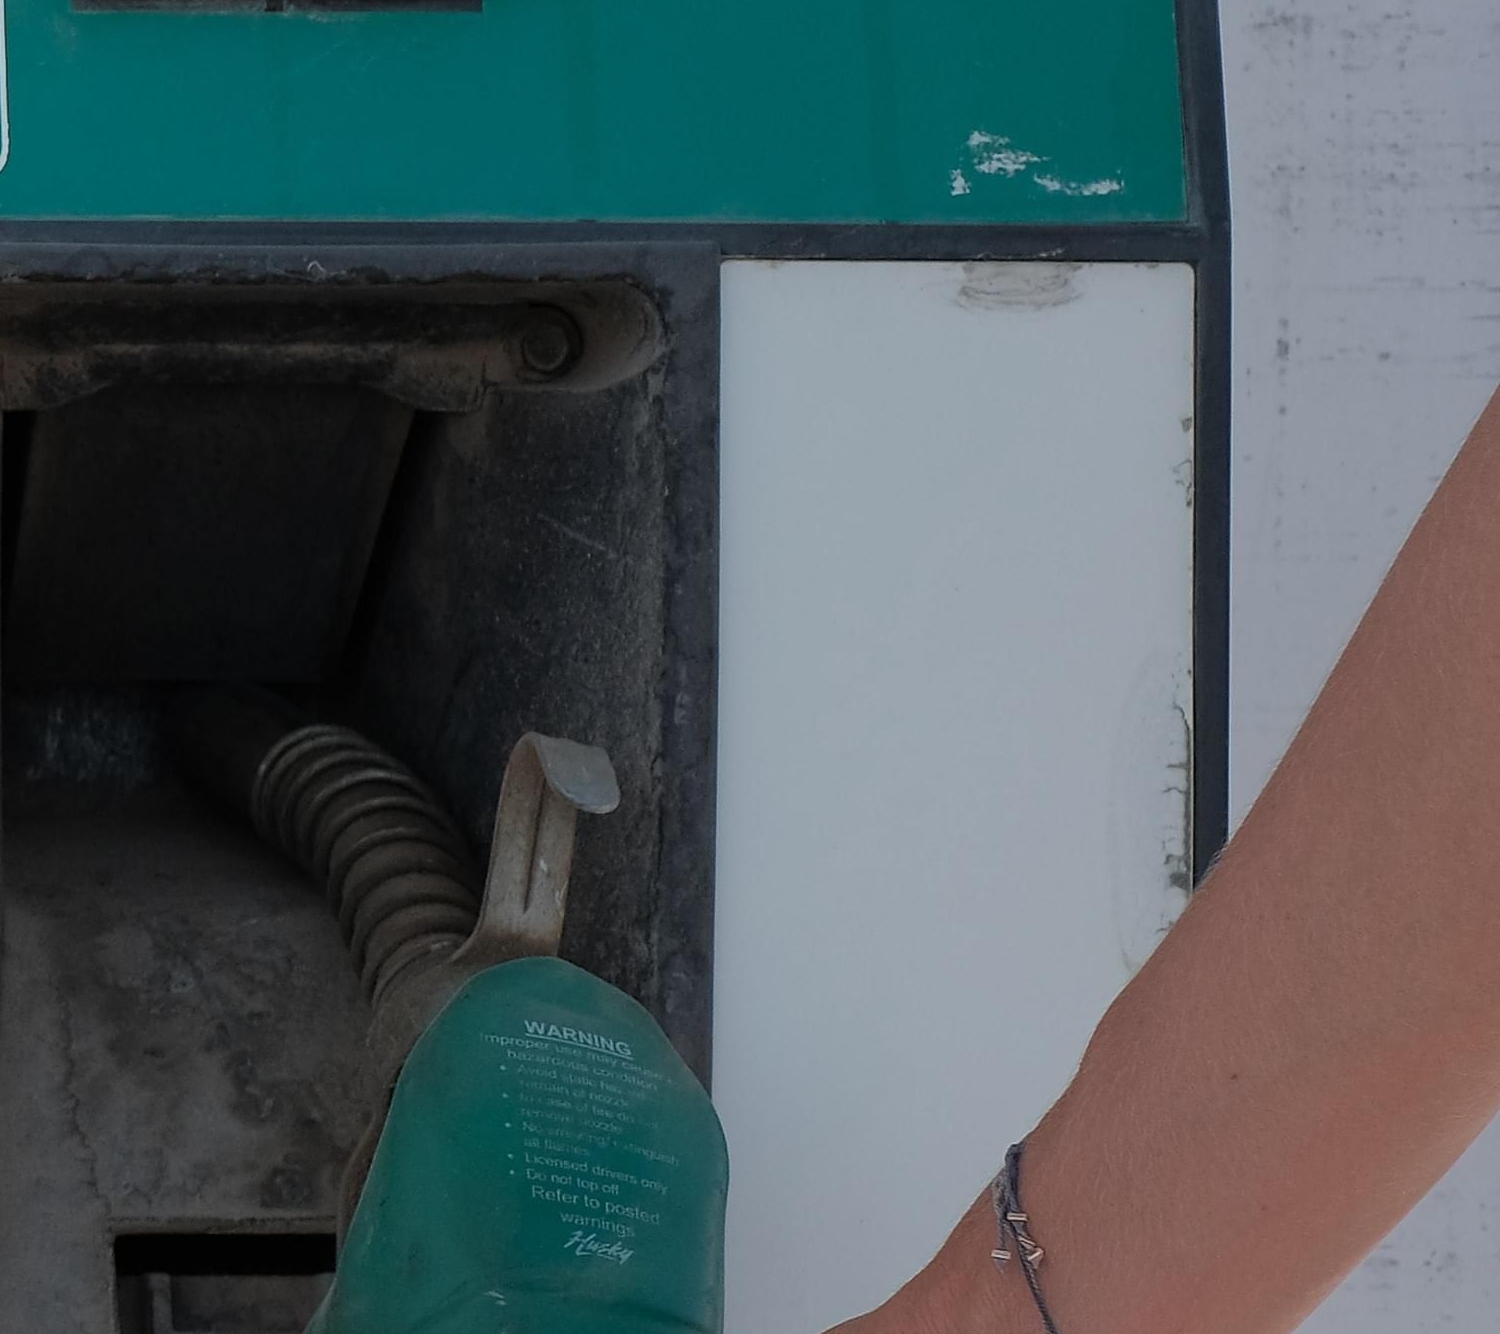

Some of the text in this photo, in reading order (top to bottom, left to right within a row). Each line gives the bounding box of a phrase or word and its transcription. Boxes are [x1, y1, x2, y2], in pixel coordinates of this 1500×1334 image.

[524, 1019, 632, 1059] WARNING
[532, 1185, 660, 1226] Refer to posted
[560, 1212, 635, 1238] warnings
[564, 1230, 635, 1264] Husky
